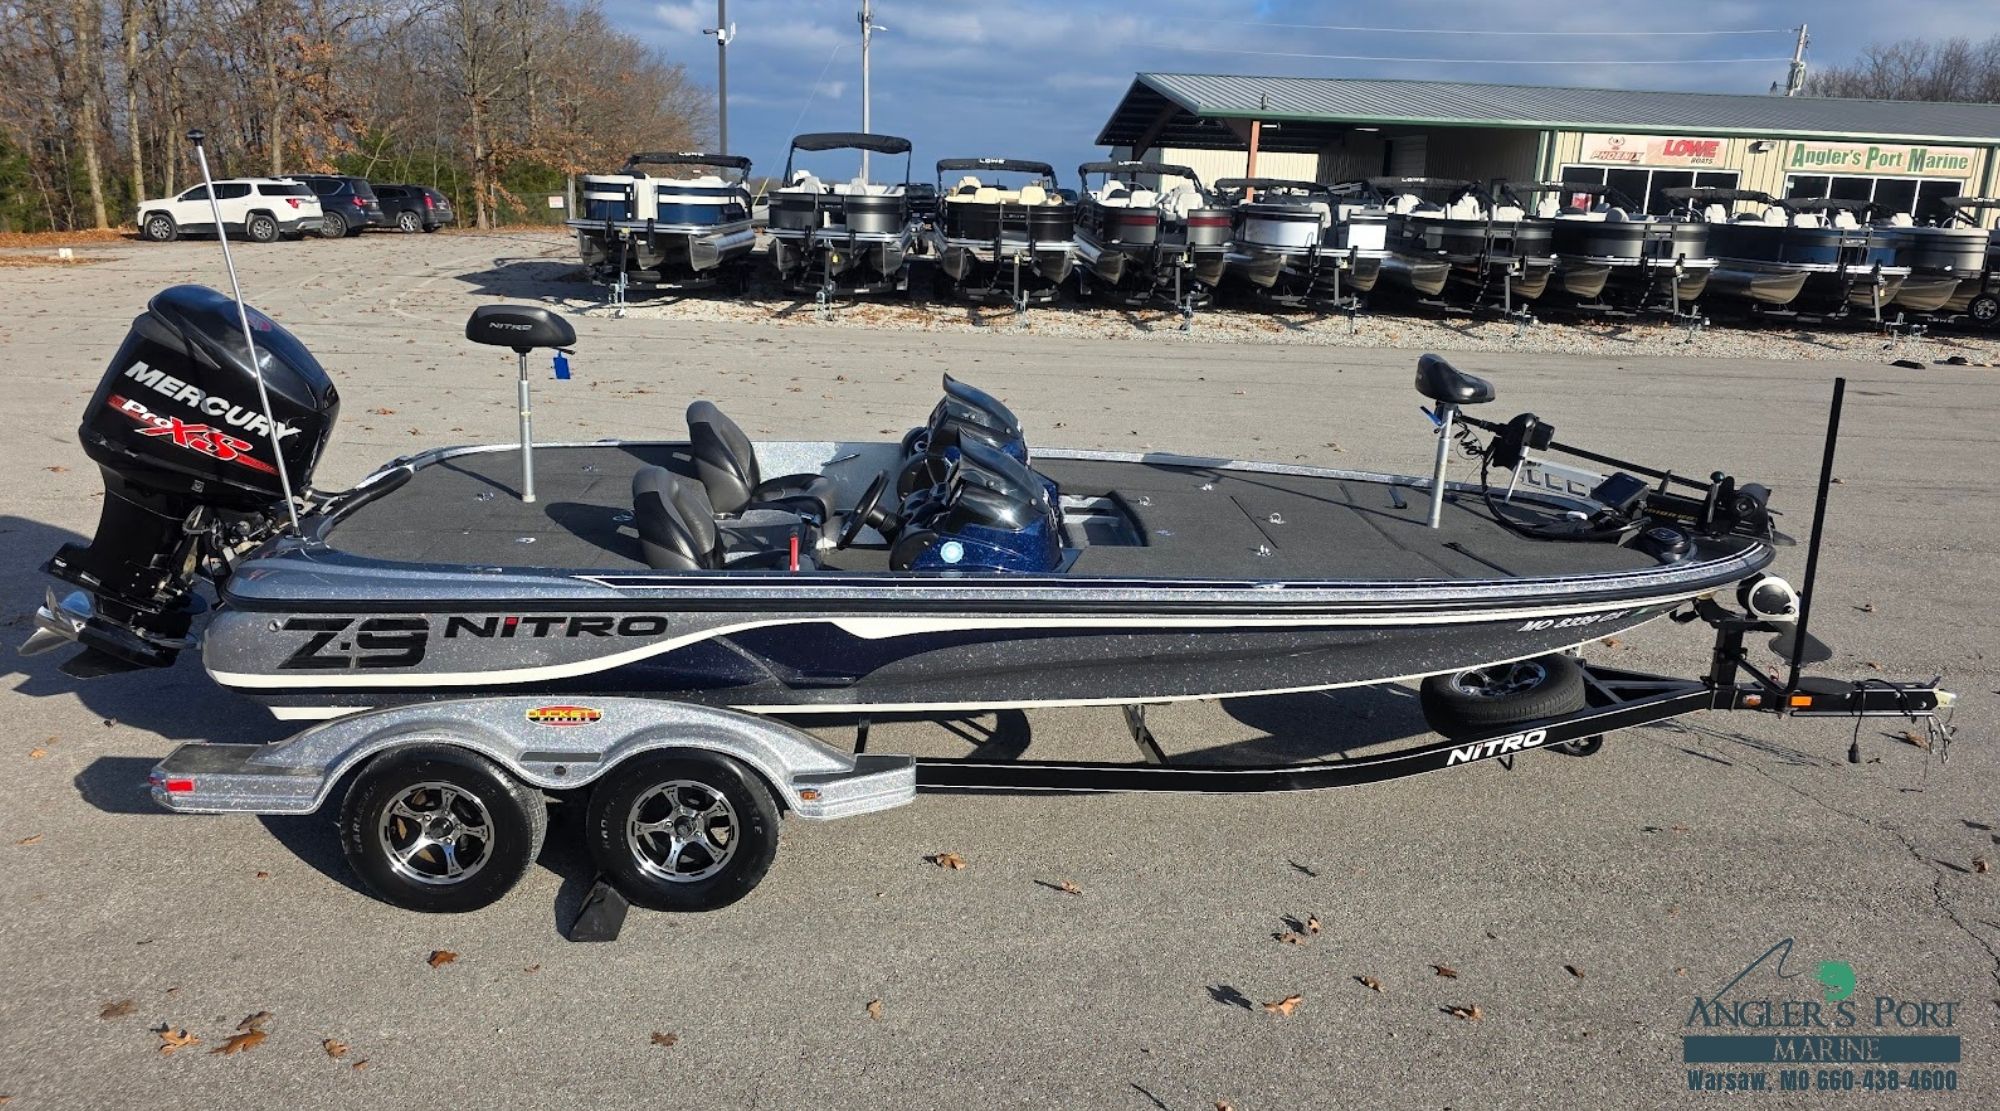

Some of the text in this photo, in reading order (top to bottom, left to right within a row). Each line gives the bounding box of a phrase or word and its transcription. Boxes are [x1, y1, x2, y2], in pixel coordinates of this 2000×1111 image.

[1663, 139, 1721, 158] LOWE
[1790, 143, 1969, 172] Angler's Port Marine
[489, 321, 533, 331] NITRO
[124, 360, 302, 441] MERCURY
[443, 616, 668, 638] NITRO
[1446, 729, 1547, 767] NITRO
